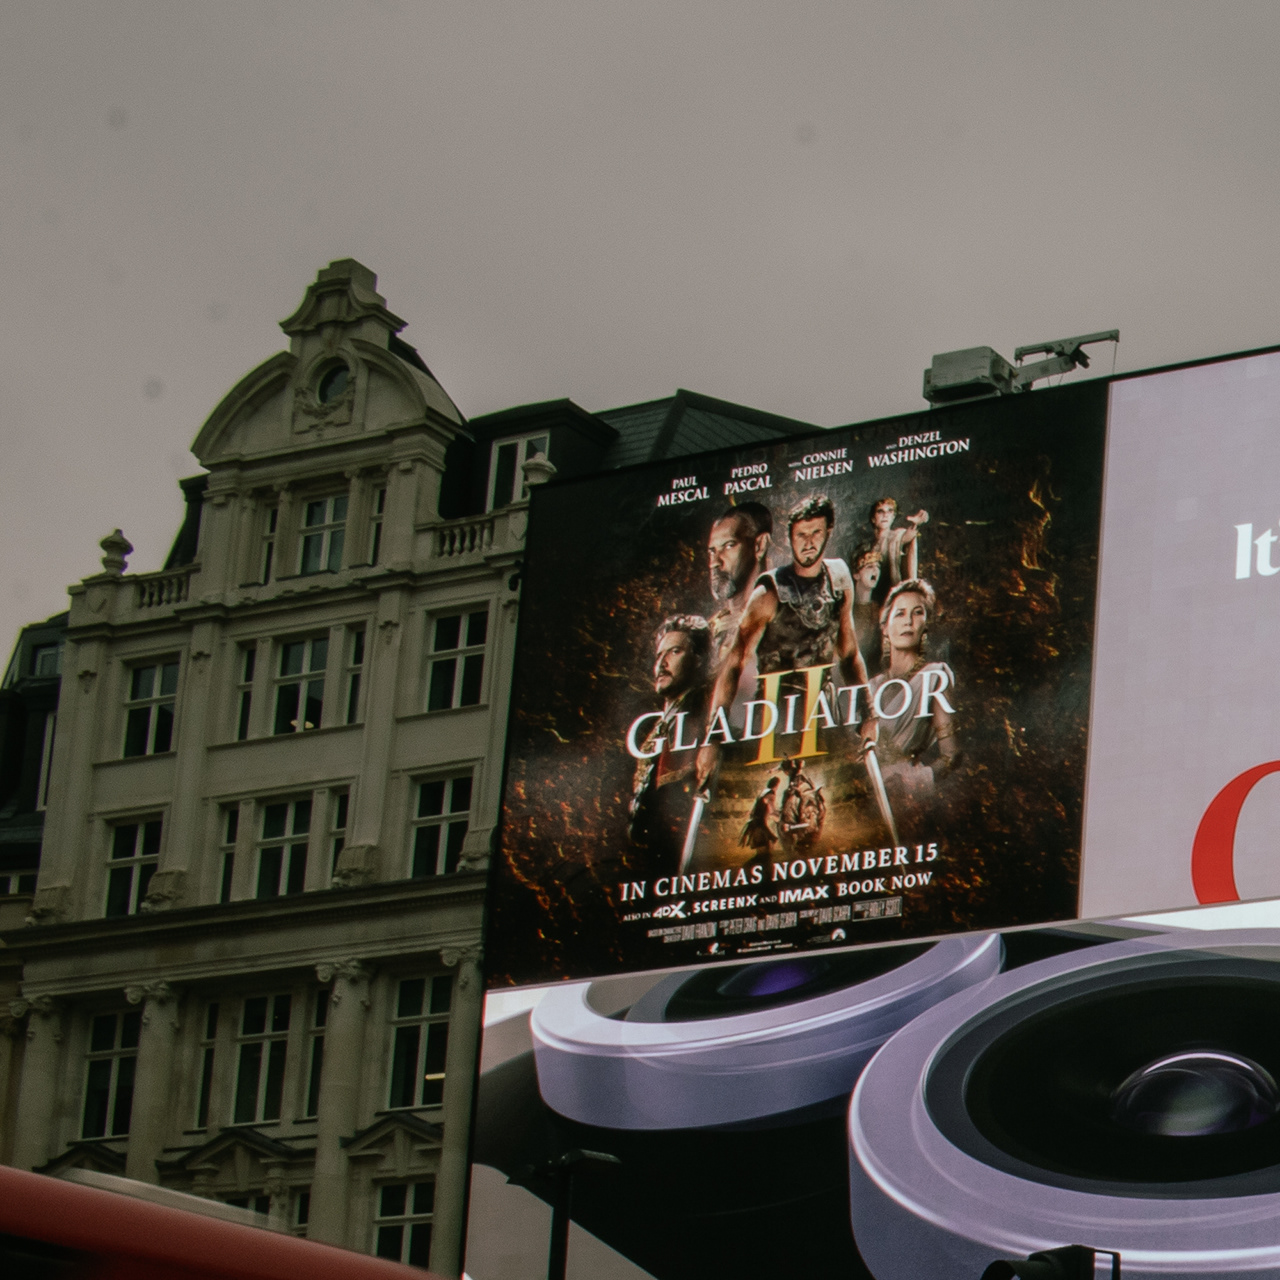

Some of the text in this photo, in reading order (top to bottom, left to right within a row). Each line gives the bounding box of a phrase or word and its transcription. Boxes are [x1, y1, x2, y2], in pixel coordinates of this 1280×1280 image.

[898, 430, 942, 448] DENZEL
[802, 448, 847, 466] CONNIE
[868, 438, 970, 468] WASHINGTON
[731, 463, 768, 479] PEDRO
[794, 459, 853, 482] NIELSEN
[672, 475, 698, 489] PAUL
[724, 474, 772, 496] PASCAL
[657, 486, 709, 507] MESCAL
[626, 668, 956, 759] GLADIATOR
[620, 842, 938, 902] IN CINEMAS NOVEMBER 15
[692, 894, 759, 915] SCREENX
[759, 895, 778, 904] AND
[777, 884, 830, 904] IMAX
[836, 878, 885, 897] BOOK
[890, 871, 934, 891] NOW
